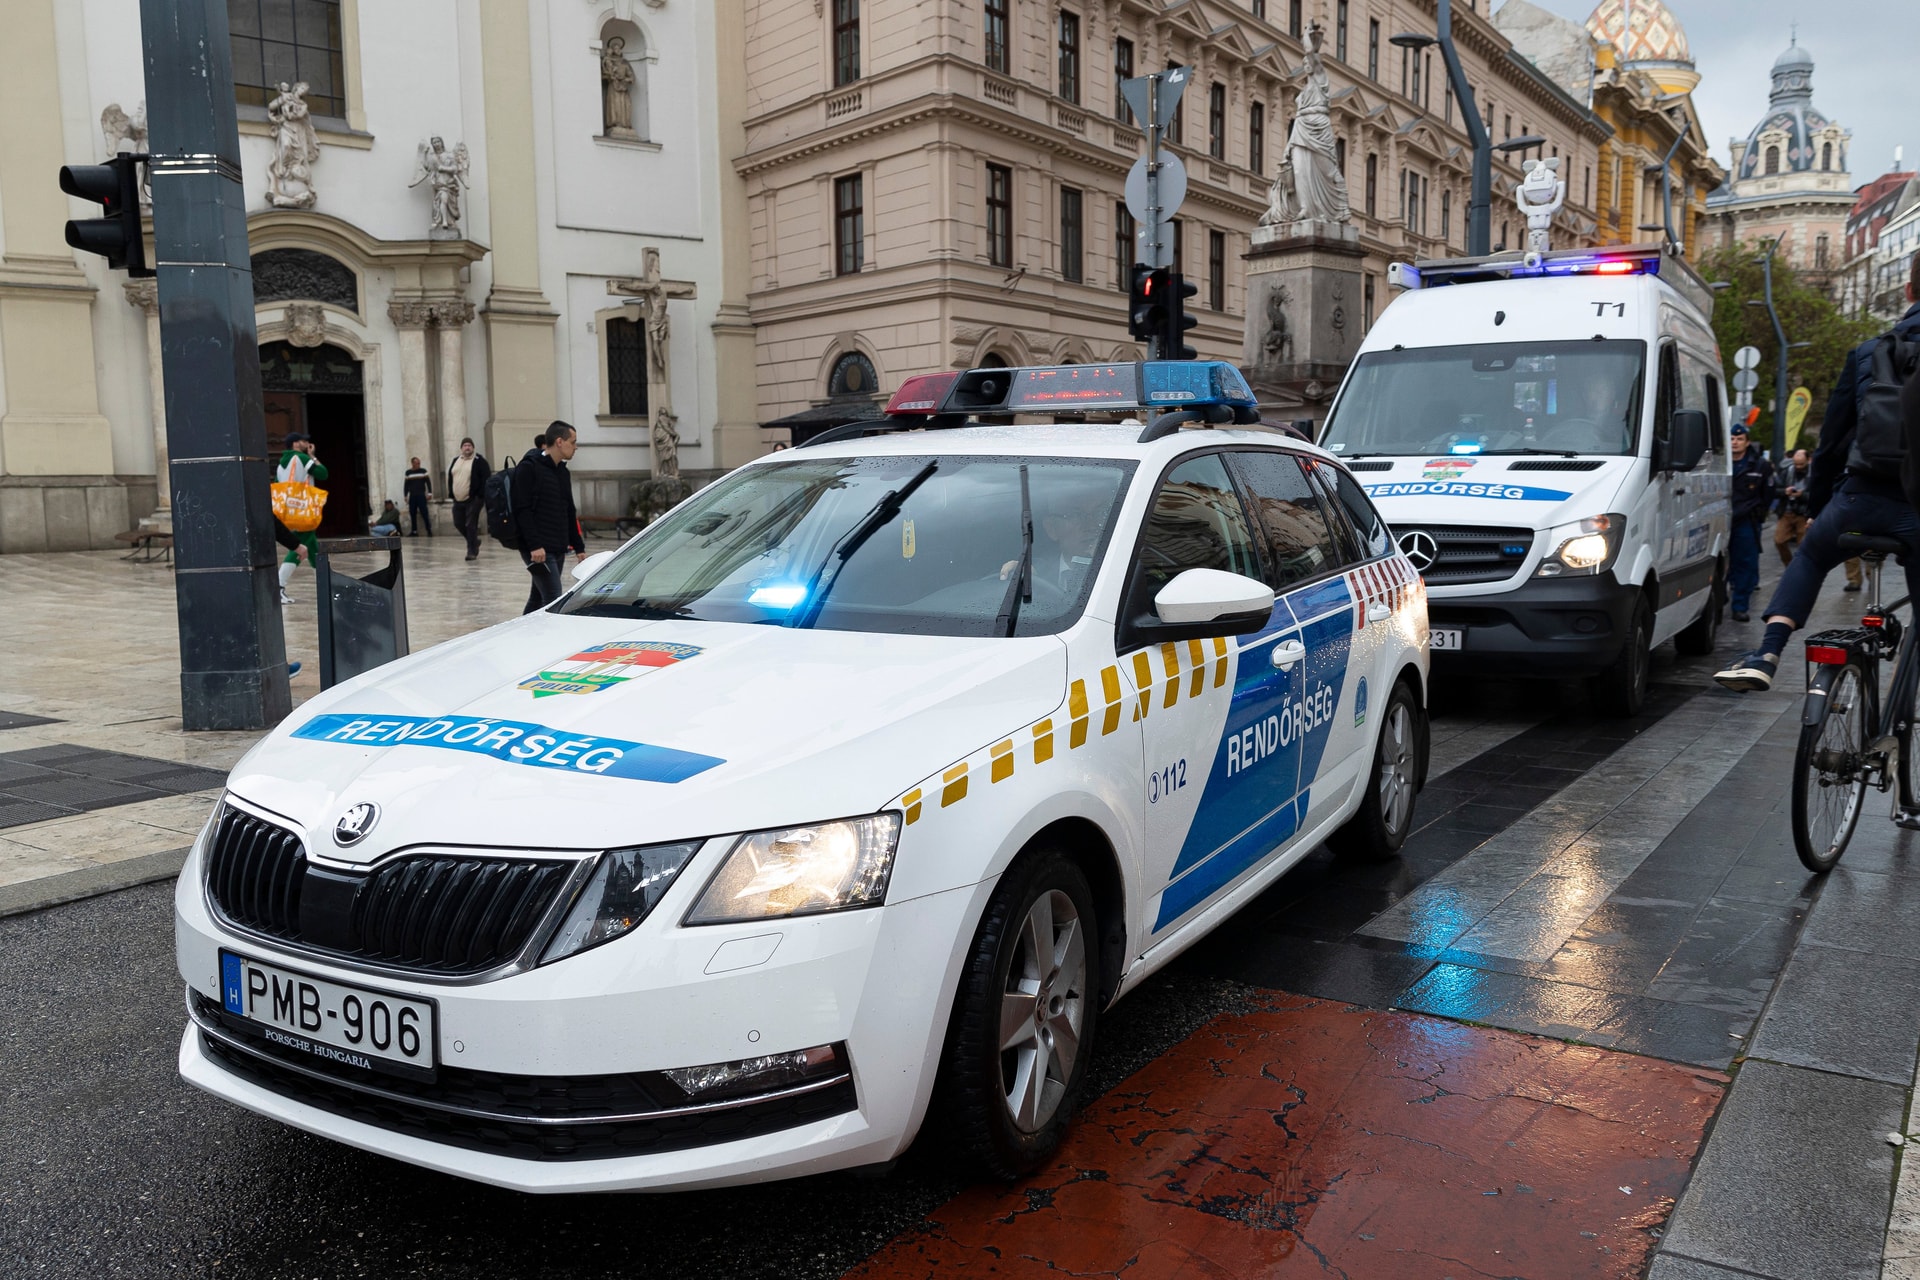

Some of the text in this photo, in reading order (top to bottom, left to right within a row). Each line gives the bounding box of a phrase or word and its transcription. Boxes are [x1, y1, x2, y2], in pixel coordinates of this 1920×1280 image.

[1591, 302, 1625, 317] T1
[532, 682, 589, 693] POLICE
[325, 719, 624, 773] RENDŐRSÉG
[1227, 681, 1332, 778] RENDŐRSÉG
[1163, 758, 1187, 796] 112
[229, 967, 420, 1057] H PMB-906
[264, 1029, 372, 1070] PORSCHE HUNGARIA
